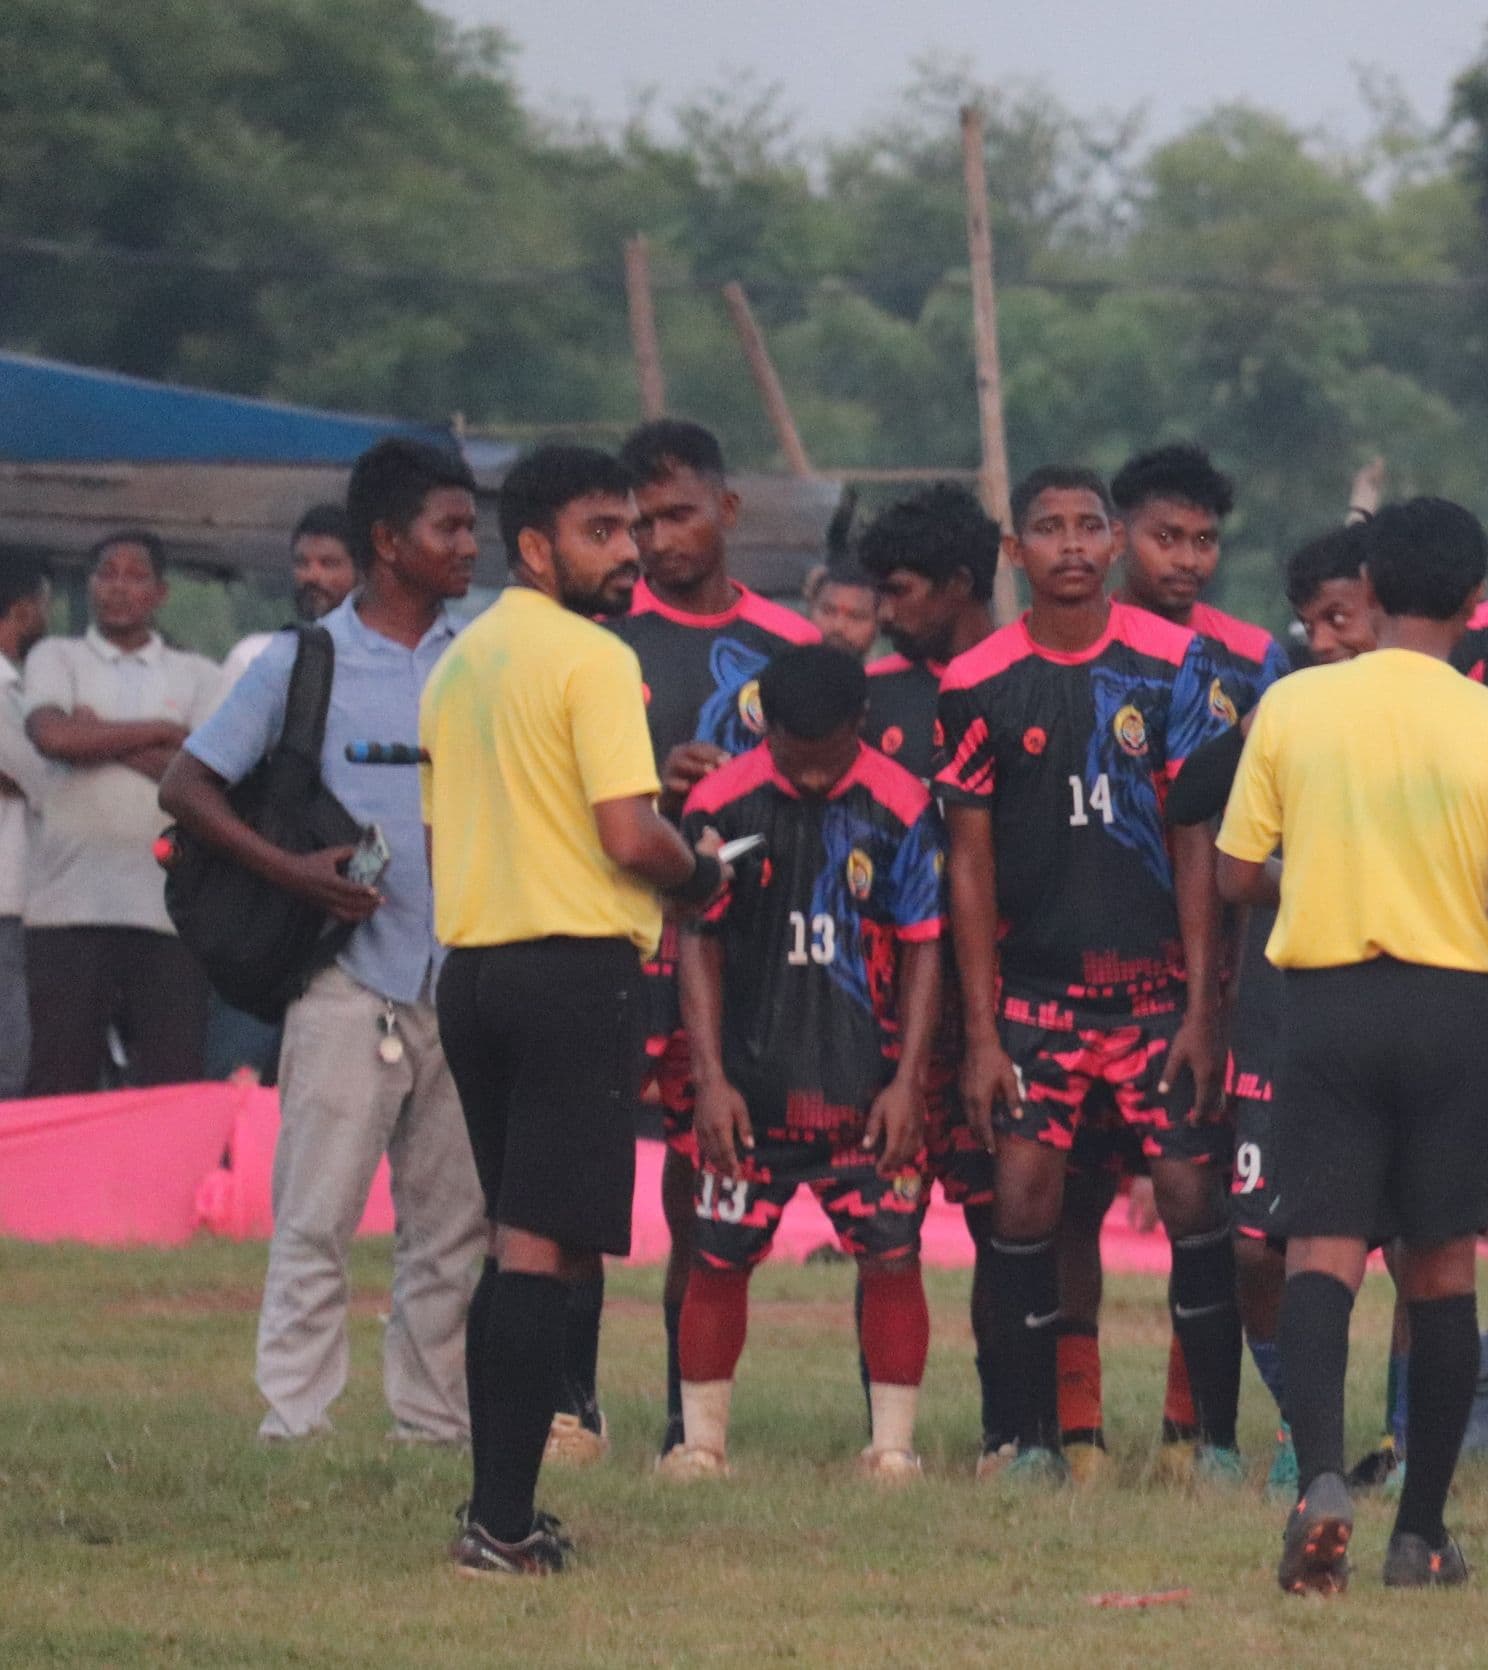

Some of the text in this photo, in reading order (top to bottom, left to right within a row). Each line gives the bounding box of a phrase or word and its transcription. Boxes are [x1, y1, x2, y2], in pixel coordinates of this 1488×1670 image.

[1069, 773, 1114, 826] 14
[788, 911, 835, 964] 13
[1236, 1142, 1261, 1194] 9
[696, 1171, 749, 1222] 13
